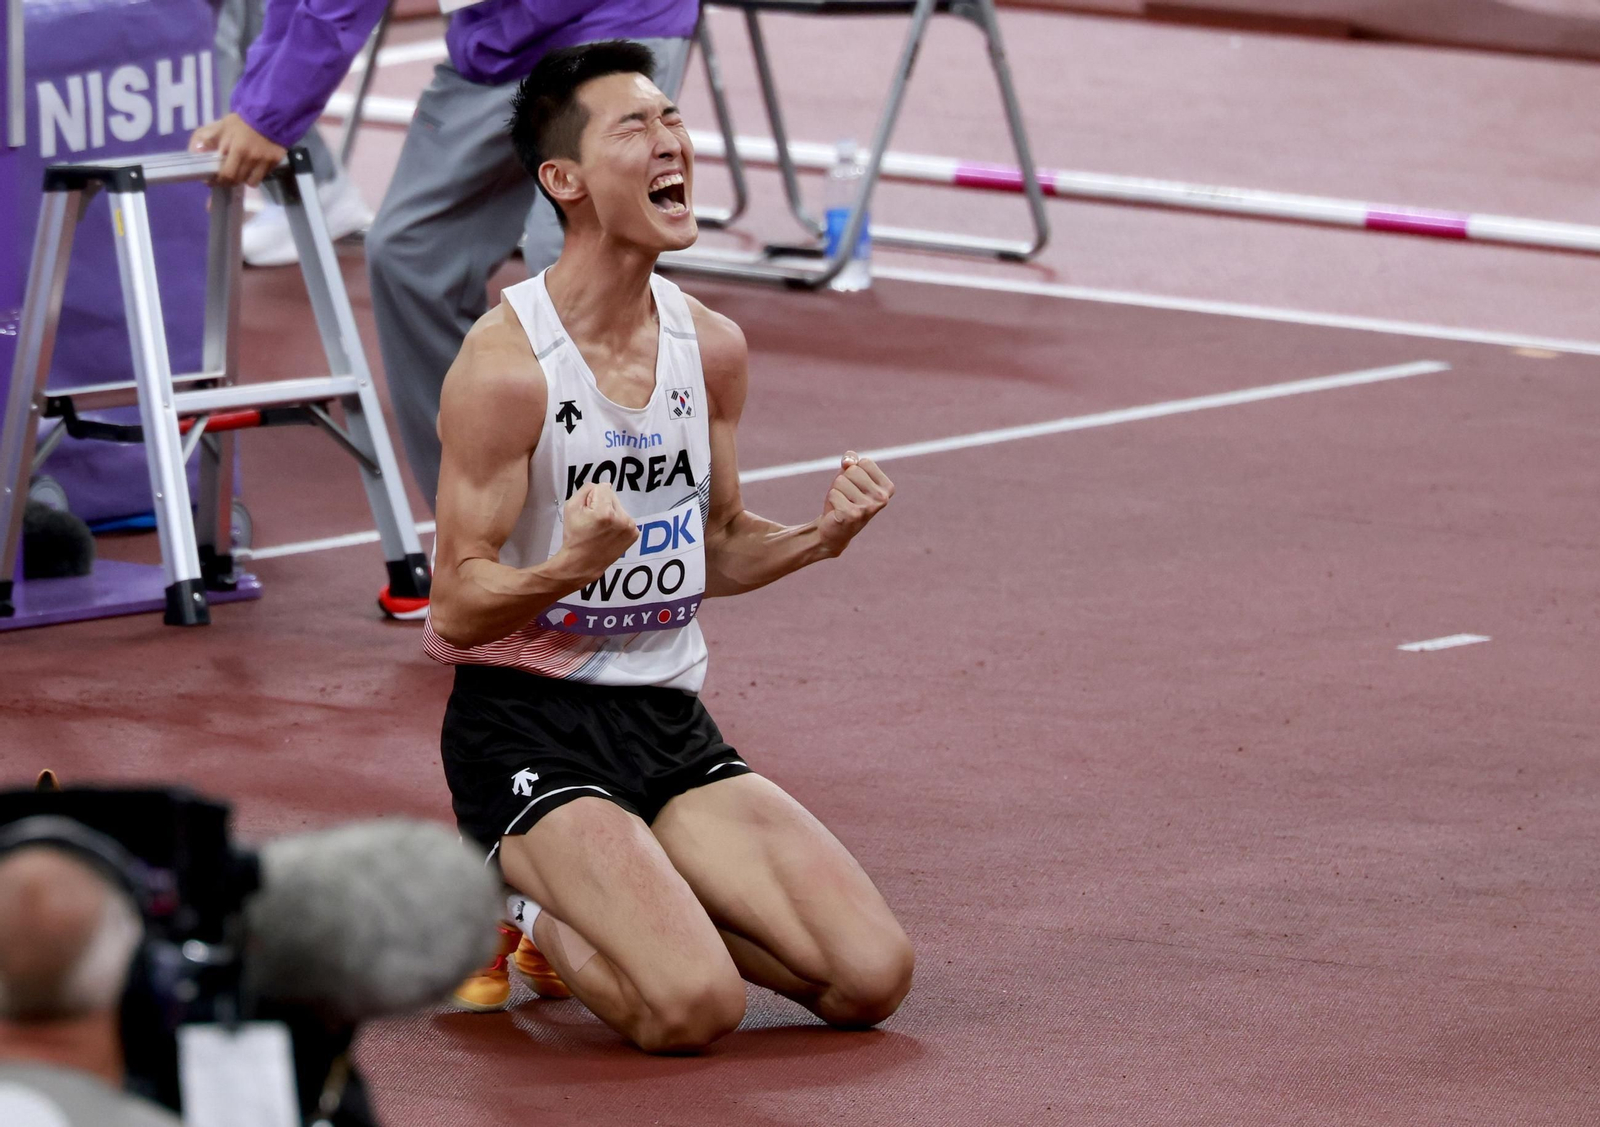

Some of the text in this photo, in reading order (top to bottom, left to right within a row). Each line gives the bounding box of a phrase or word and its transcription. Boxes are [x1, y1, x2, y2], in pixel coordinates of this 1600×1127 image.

[36, 51, 214, 158] NISHI
[605, 430, 662, 449] Shinhn
[565, 449, 695, 500] KOREA
[580, 559, 685, 601] WOO
